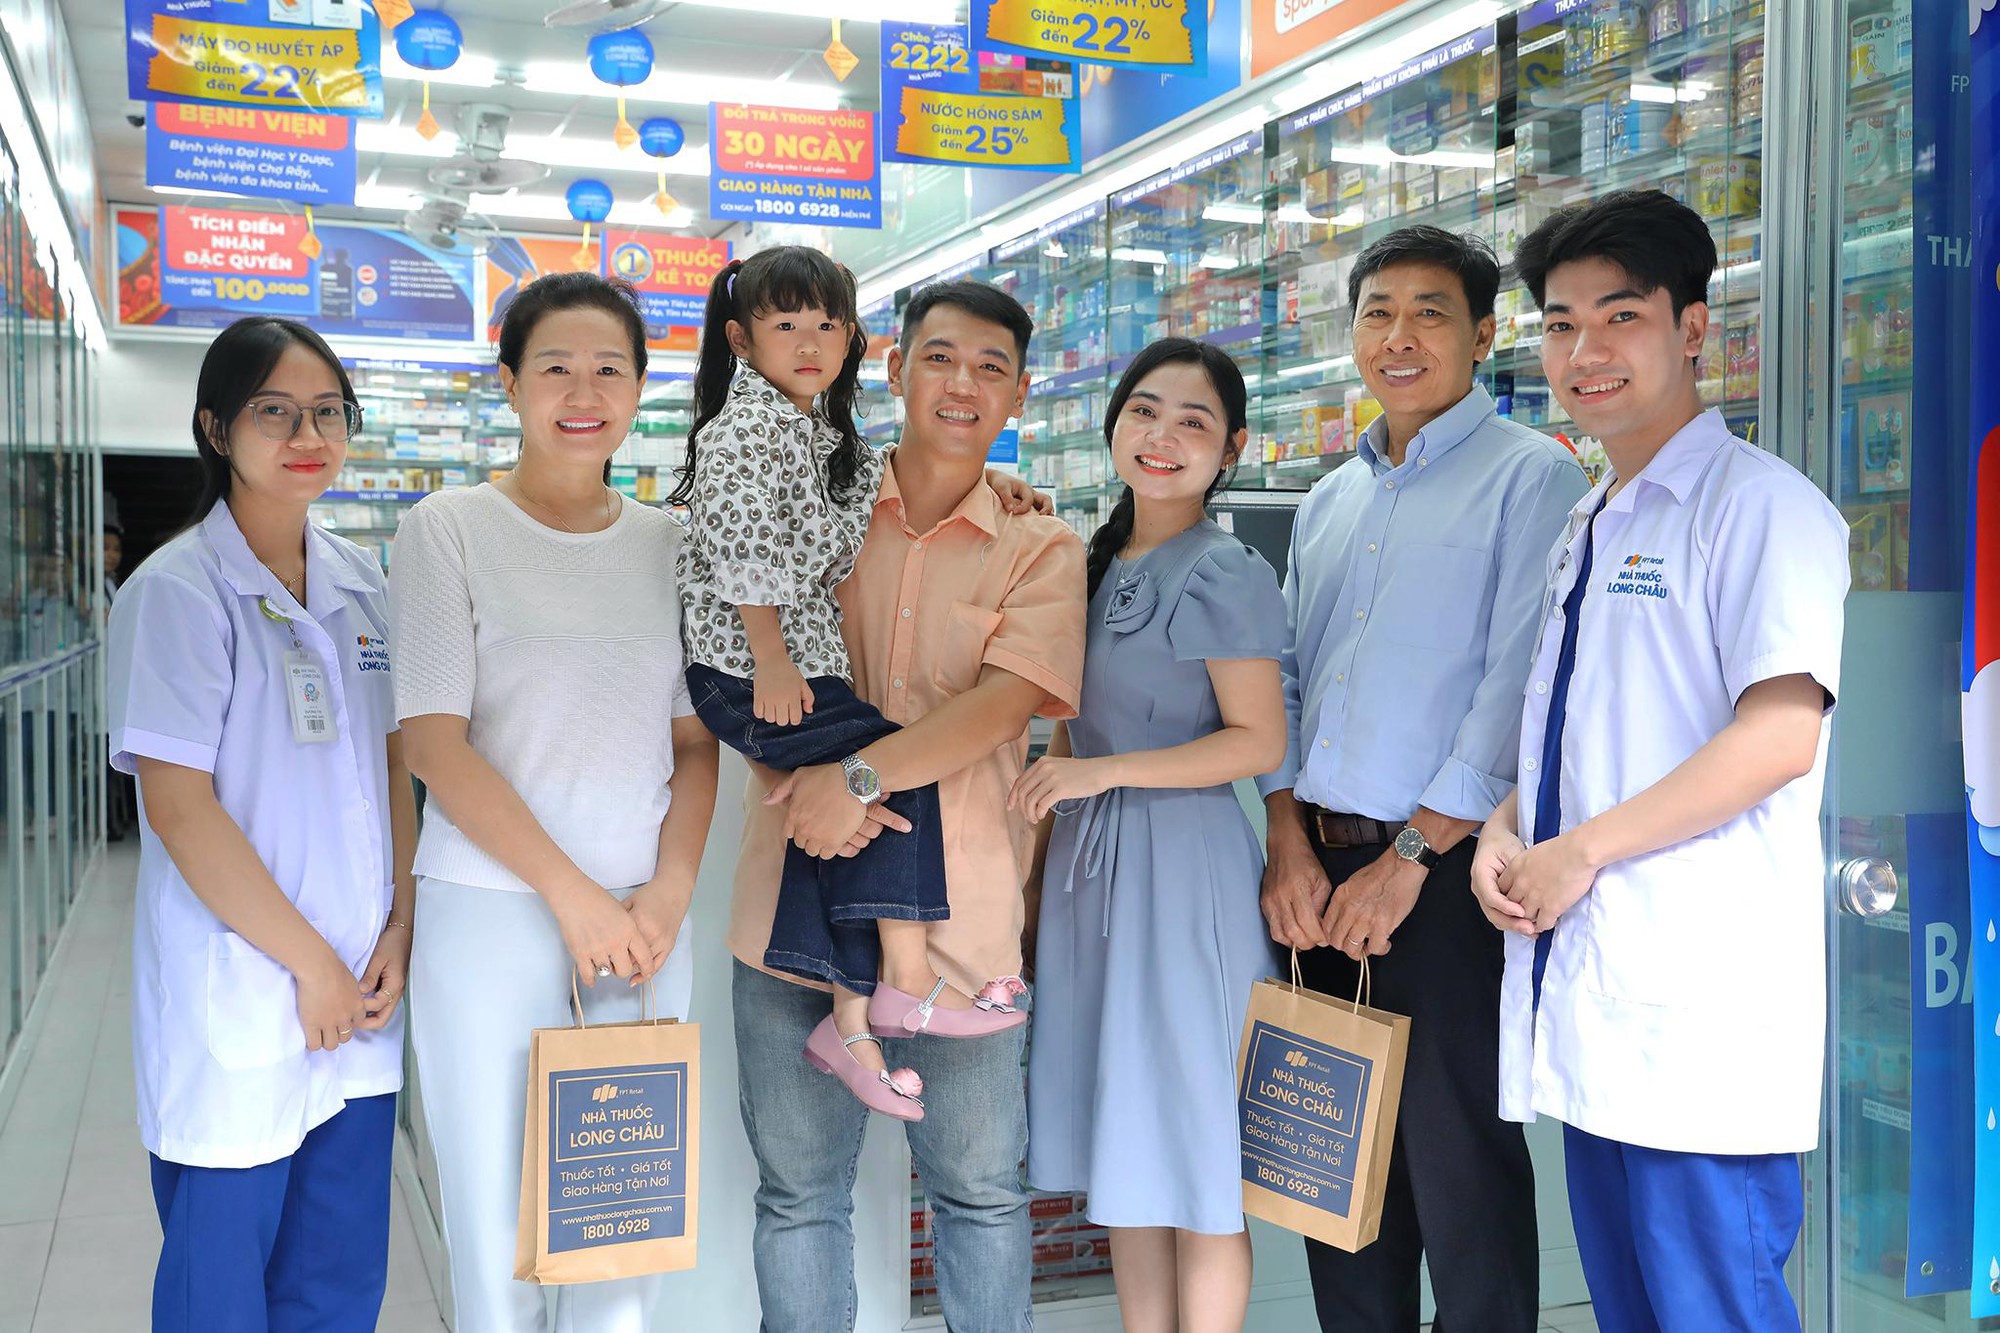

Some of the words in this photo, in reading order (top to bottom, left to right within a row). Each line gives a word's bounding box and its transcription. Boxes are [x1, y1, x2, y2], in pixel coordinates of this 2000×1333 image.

[1031, 8, 1069, 26] Giảm
[1041, 28, 1069, 44] đến
[1072, 12, 1151, 54] 22%
[179, 32, 218, 49] MÁY
[224, 39, 251, 53] ĐO
[256, 38, 315, 57] HUYẾT
[321, 41, 344, 58] ÁP
[891, 42, 969, 74] 2222
[206, 78, 236, 92] đến
[239, 62, 322, 98] 22%
[782, 111, 826, 127] TRONG
[921, 100, 963, 118] NƯỚC
[967, 105, 1008, 121] HỒNG
[1013, 107, 1043, 121] SÂM
[262, 110, 327, 139] VIỆN
[931, 123, 963, 136] Giảm
[169, 139, 204, 153] Bệnh
[206, 143, 234, 157] viện
[261, 149, 285, 162] Học
[289, 151, 298, 162] Y
[725, 130, 765, 157] 30
[775, 131, 865, 164] NGÀY
[965, 124, 1029, 155] 25%
[193, 156, 226, 169] bệnh
[229, 159, 256, 173] viện
[175, 169, 208, 182] bệnh
[211, 172, 238, 185] viện
[260, 178, 292, 190] khoa
[718, 178, 757, 193] GIAO
[760, 179, 804, 197] HÀNG
[807, 183, 836, 200] TẬN
[840, 183, 873, 201] NHÀ
[755, 198, 795, 215] 1800
[798, 202, 840, 219] 6928
[190, 214, 236, 233] TÍCH
[238, 214, 285, 236] ĐIỂM
[211, 235, 265, 252] NHẬN
[184, 252, 225, 269] ĐẶC
[229, 251, 292, 271] QUYỀN
[654, 247, 723, 270] THUỐC
[655, 268, 679, 285] KÊ
[1618, 569, 1633, 580] NHÀ
[1634, 569, 1662, 582] THUỐC
[1607, 582, 1634, 594] LONG
[1635, 584, 1667, 599] CHÂU
[360, 649, 373, 659] NHÀ
[358, 661, 381, 672] LONG
[1272, 1067, 1294, 1085] NHÀ
[1298, 1076, 1336, 1099] THUỐC
[1259, 1080, 1300, 1106] LONG
[1302, 1097, 1344, 1122] CHÂU
[581, 1108, 607, 1125] NHÀ
[610, 1103, 654, 1121] THUỐC
[570, 1129, 616, 1148] LONG
[619, 1121, 665, 1143] CHÂU
[1247, 1109, 1276, 1129] Thuốc
[1278, 1121, 1295, 1136] Tốt
[1307, 1133, 1326, 1147] Giá
[1328, 1138, 1345, 1154] Tốt
[1245, 1124, 1269, 1141] Giao
[1271, 1133, 1299, 1154] Hàng
[1301, 1144, 1321, 1160] Tận
[1322, 1152, 1341, 1167] Nơi
[560, 1166, 595, 1182] Thuốc
[598, 1163, 616, 1178] Tốt
[631, 1161, 651, 1174] Giá
[653, 1158, 672, 1171] Tốt
[1241, 1150, 1341, 1191] www.nhathuoclongchau.com.vn
[562, 1184, 589, 1198] Giao
[592, 1181, 623, 1195] Hàng
[625, 1178, 647, 1192] Tận
[650, 1175, 670, 1187] Nơi
[1257, 1165, 1285, 1186] 1800
[1287, 1178, 1319, 1199] 6928
[561, 1204, 673, 1225] www.nhathuoclongchau.com.vn
[582, 1223, 614, 1240] 1800
[617, 1218, 650, 1235] 6928
